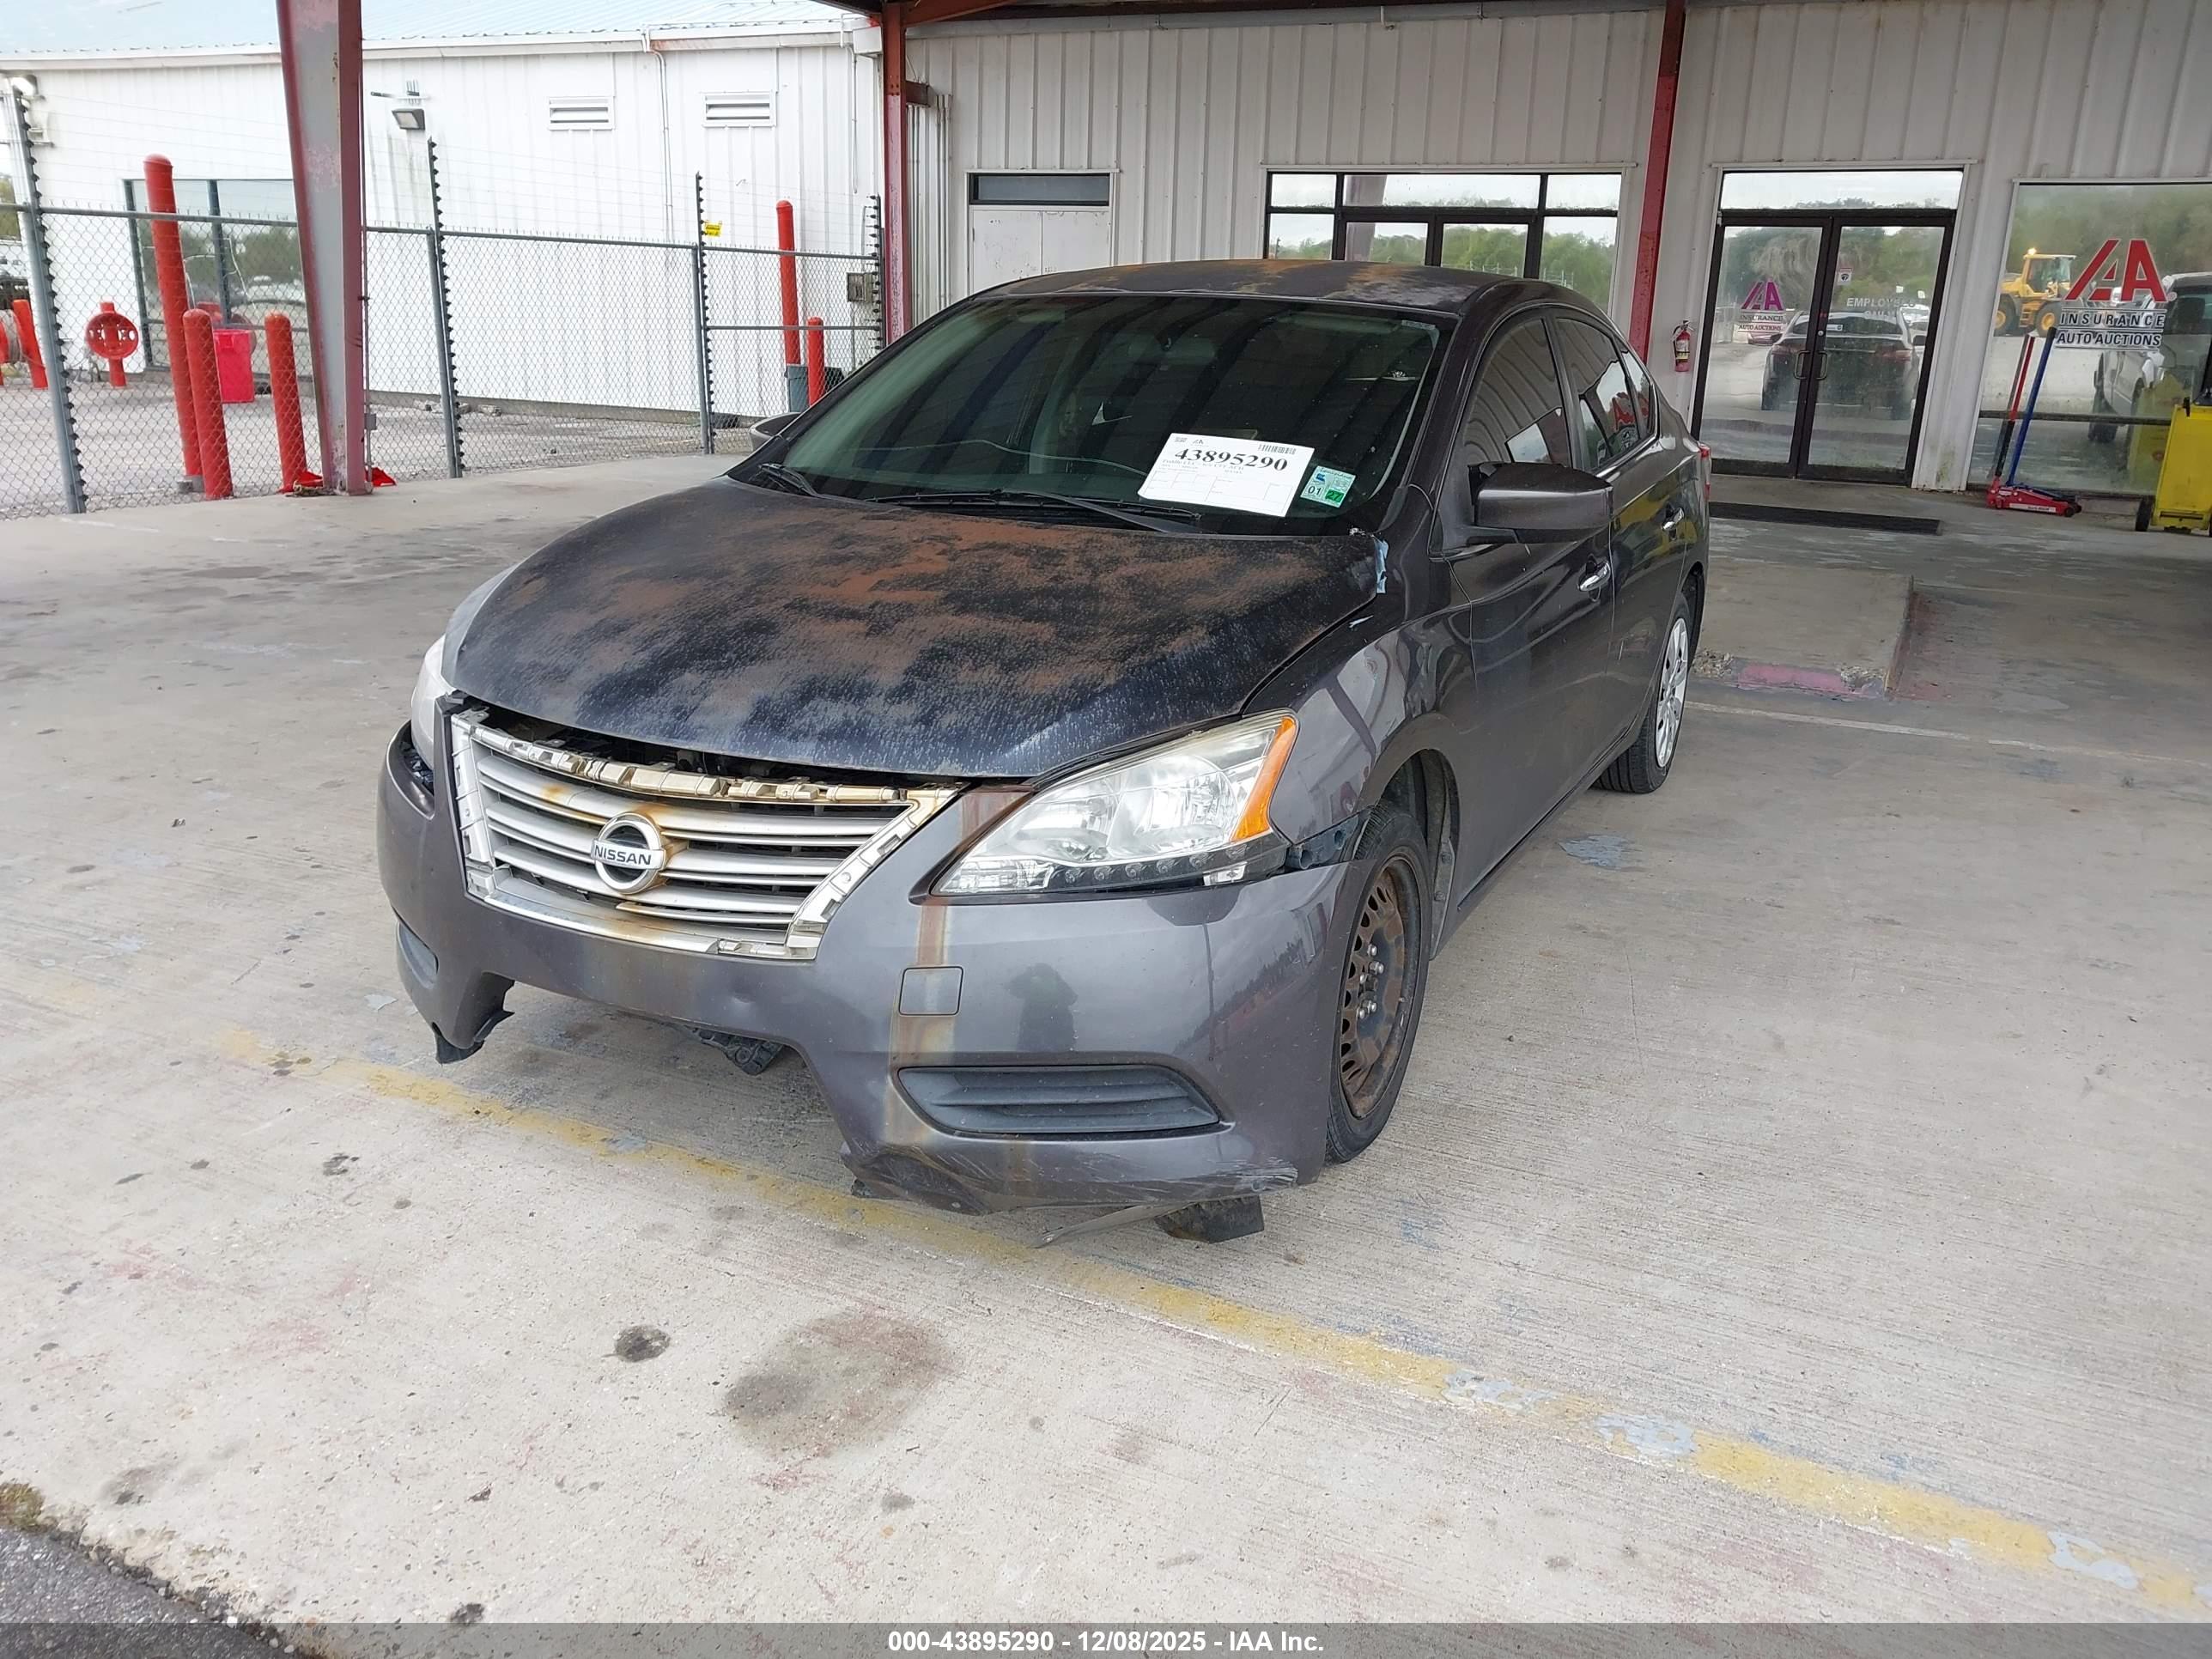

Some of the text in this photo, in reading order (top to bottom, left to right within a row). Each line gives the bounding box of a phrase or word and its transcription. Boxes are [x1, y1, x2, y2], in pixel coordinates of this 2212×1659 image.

[1846, 297, 1915, 307] EMPLOYE
[2060, 313, 2165, 326] INSURANCE
[2057, 332, 2161, 346] AUTO AUCTIONS
[1175, 447, 1287, 471] 43895290
[1308, 485, 1322, 495] 01
[1325, 490, 1341, 501] 27
[594, 844, 652, 866] NISSAN
